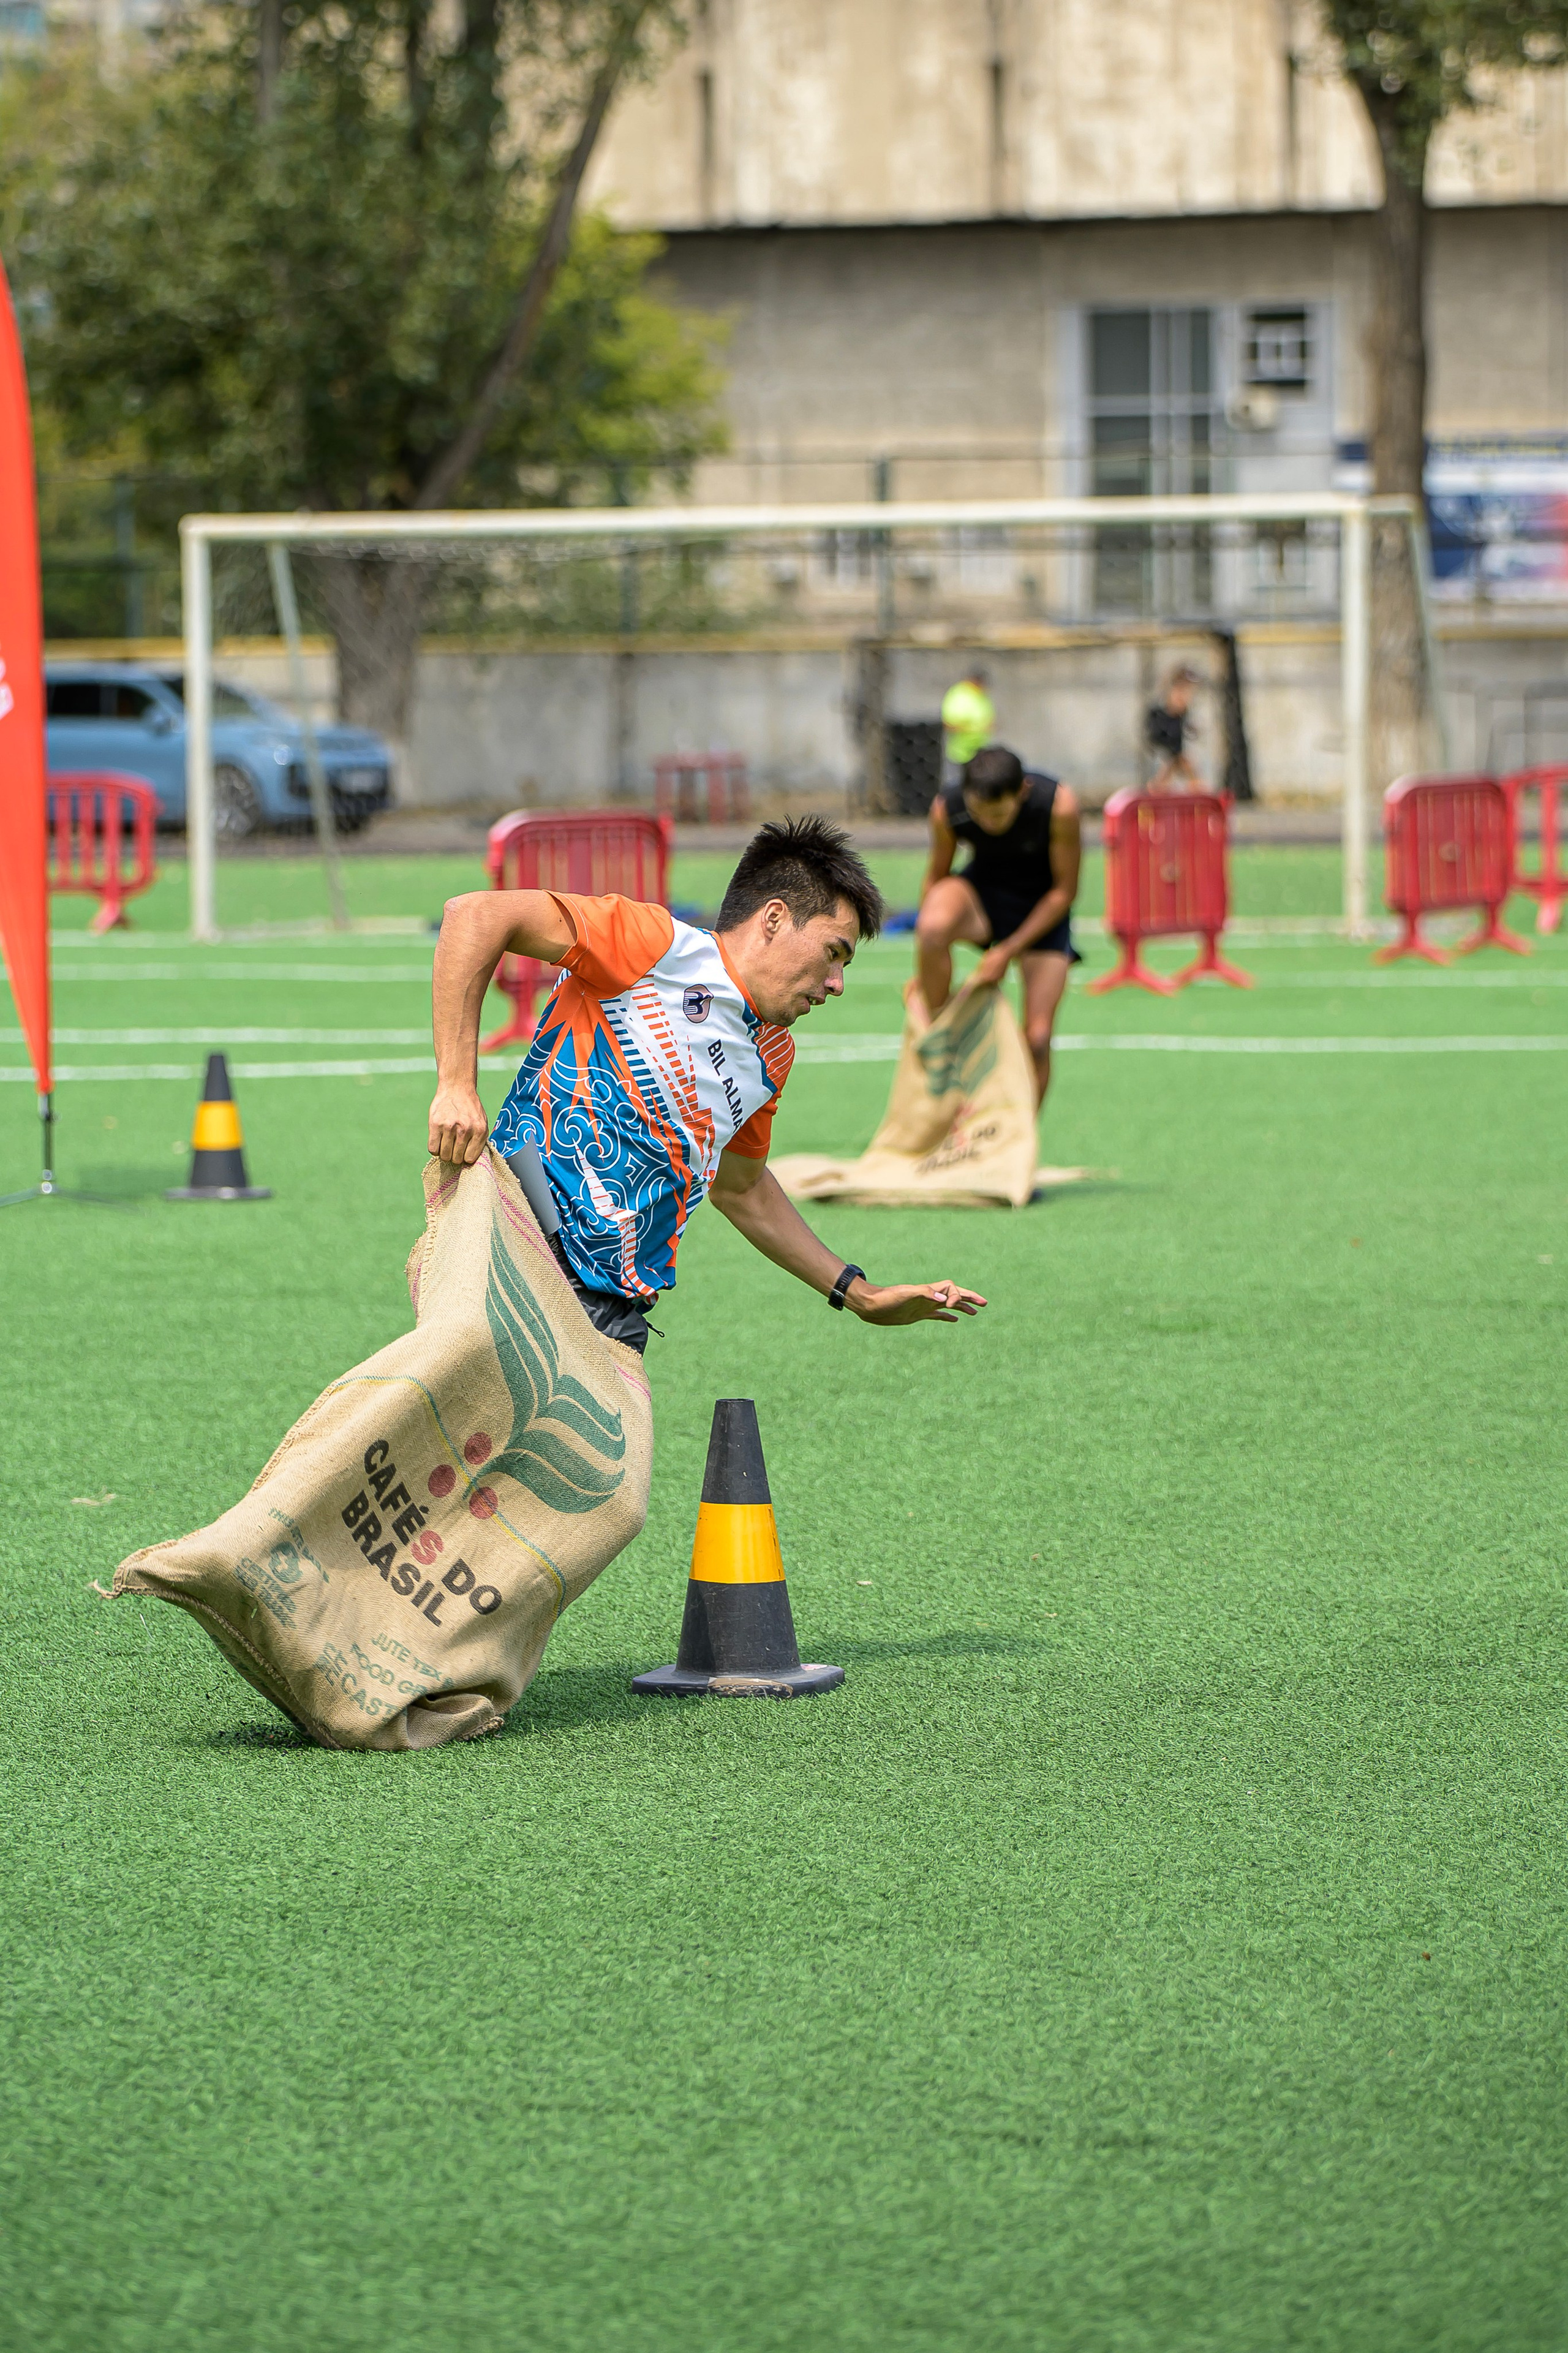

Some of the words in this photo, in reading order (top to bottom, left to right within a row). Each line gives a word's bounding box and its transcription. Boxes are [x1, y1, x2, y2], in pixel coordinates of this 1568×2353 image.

[707, 1038, 726, 1076] BIL
[722, 1076, 743, 1134] ALMA
[341, 1489, 446, 1627] BRASIL
[364, 1439, 445, 1565] CAFÉS
[440, 1558, 503, 1616] DO
[371, 1633, 411, 1663] JUTE
